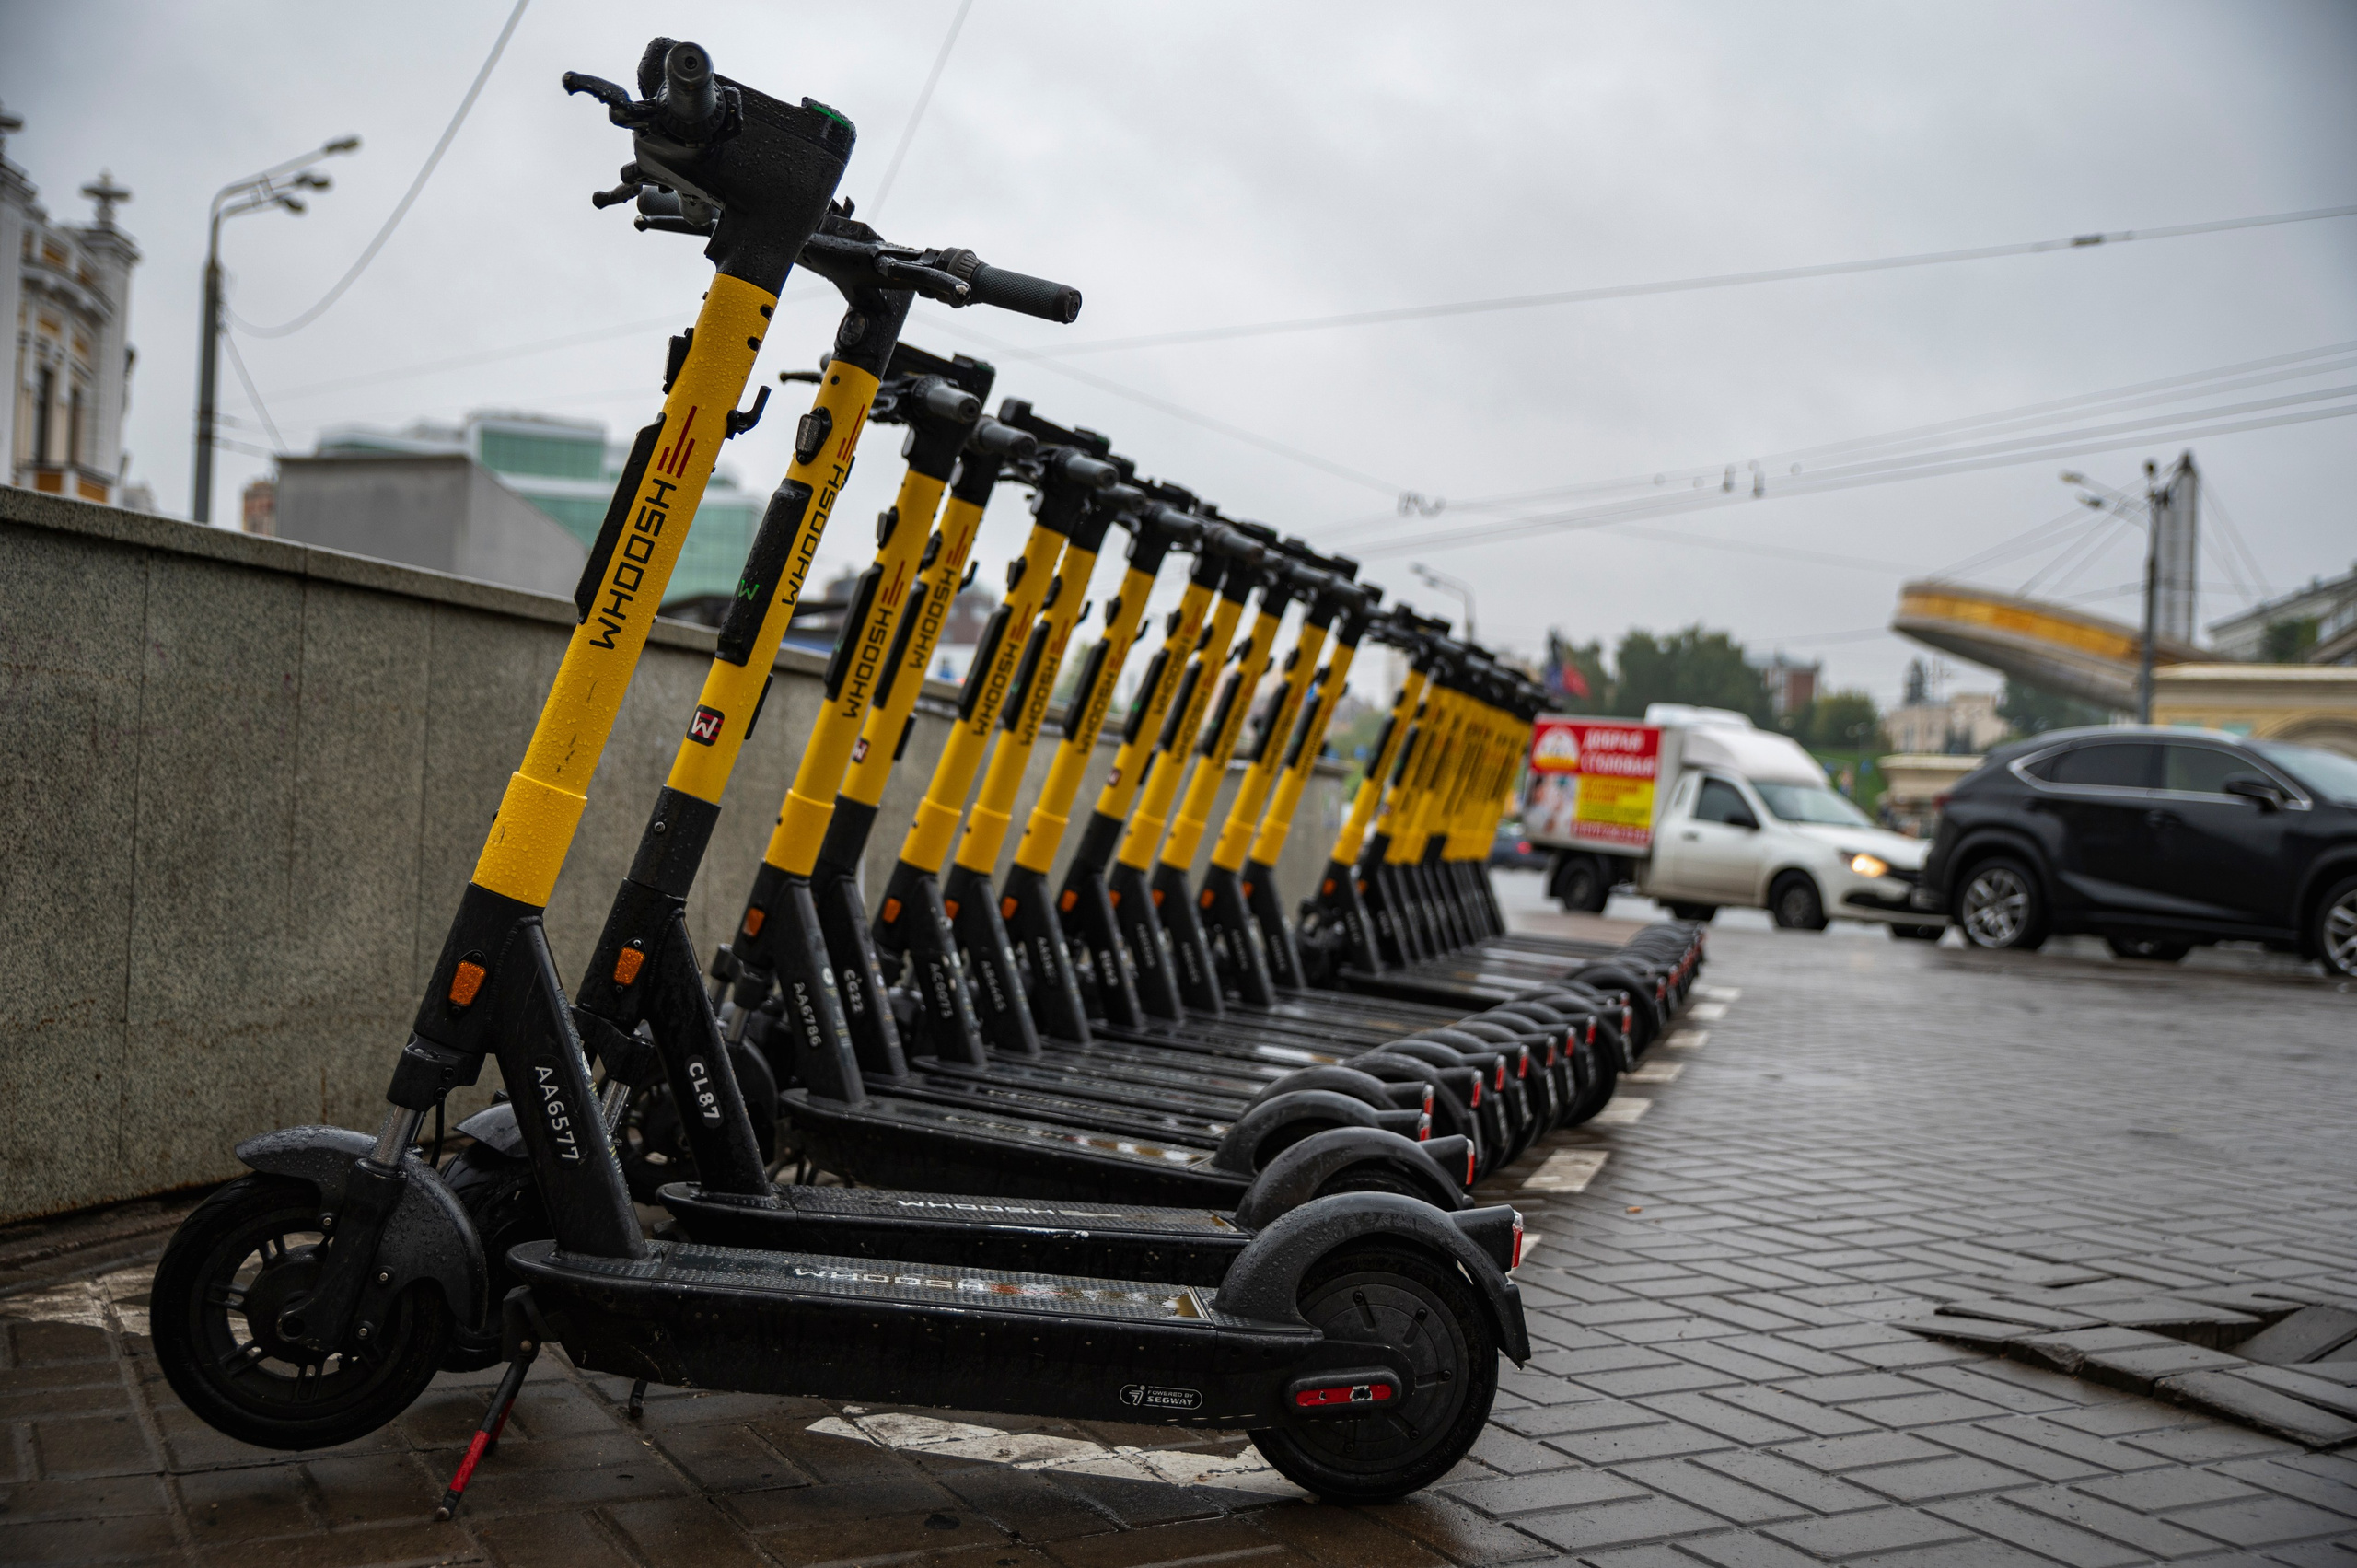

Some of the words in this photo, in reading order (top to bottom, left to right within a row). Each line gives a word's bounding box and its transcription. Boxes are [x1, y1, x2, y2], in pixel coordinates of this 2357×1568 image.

[589, 477, 677, 650] WHOOSH
[782, 463, 845, 606] WHOOSH
[737, 579, 760, 601] W
[909, 568, 957, 670] WHOOSH
[842, 608, 893, 719] WHOOSH
[972, 641, 1020, 737] WHOOSH
[1019, 656, 1060, 747] WHOOSH
[691, 711, 717, 739] W
[793, 981, 822, 1048] AA6786
[535, 1066, 580, 1161] AA6577
[689, 1062, 721, 1120] CL87
[897, 1199, 1055, 1216] WHOOSH
[795, 1267, 984, 1291] WHOOSH
[1146, 1396, 1194, 1406] SEGWAY
